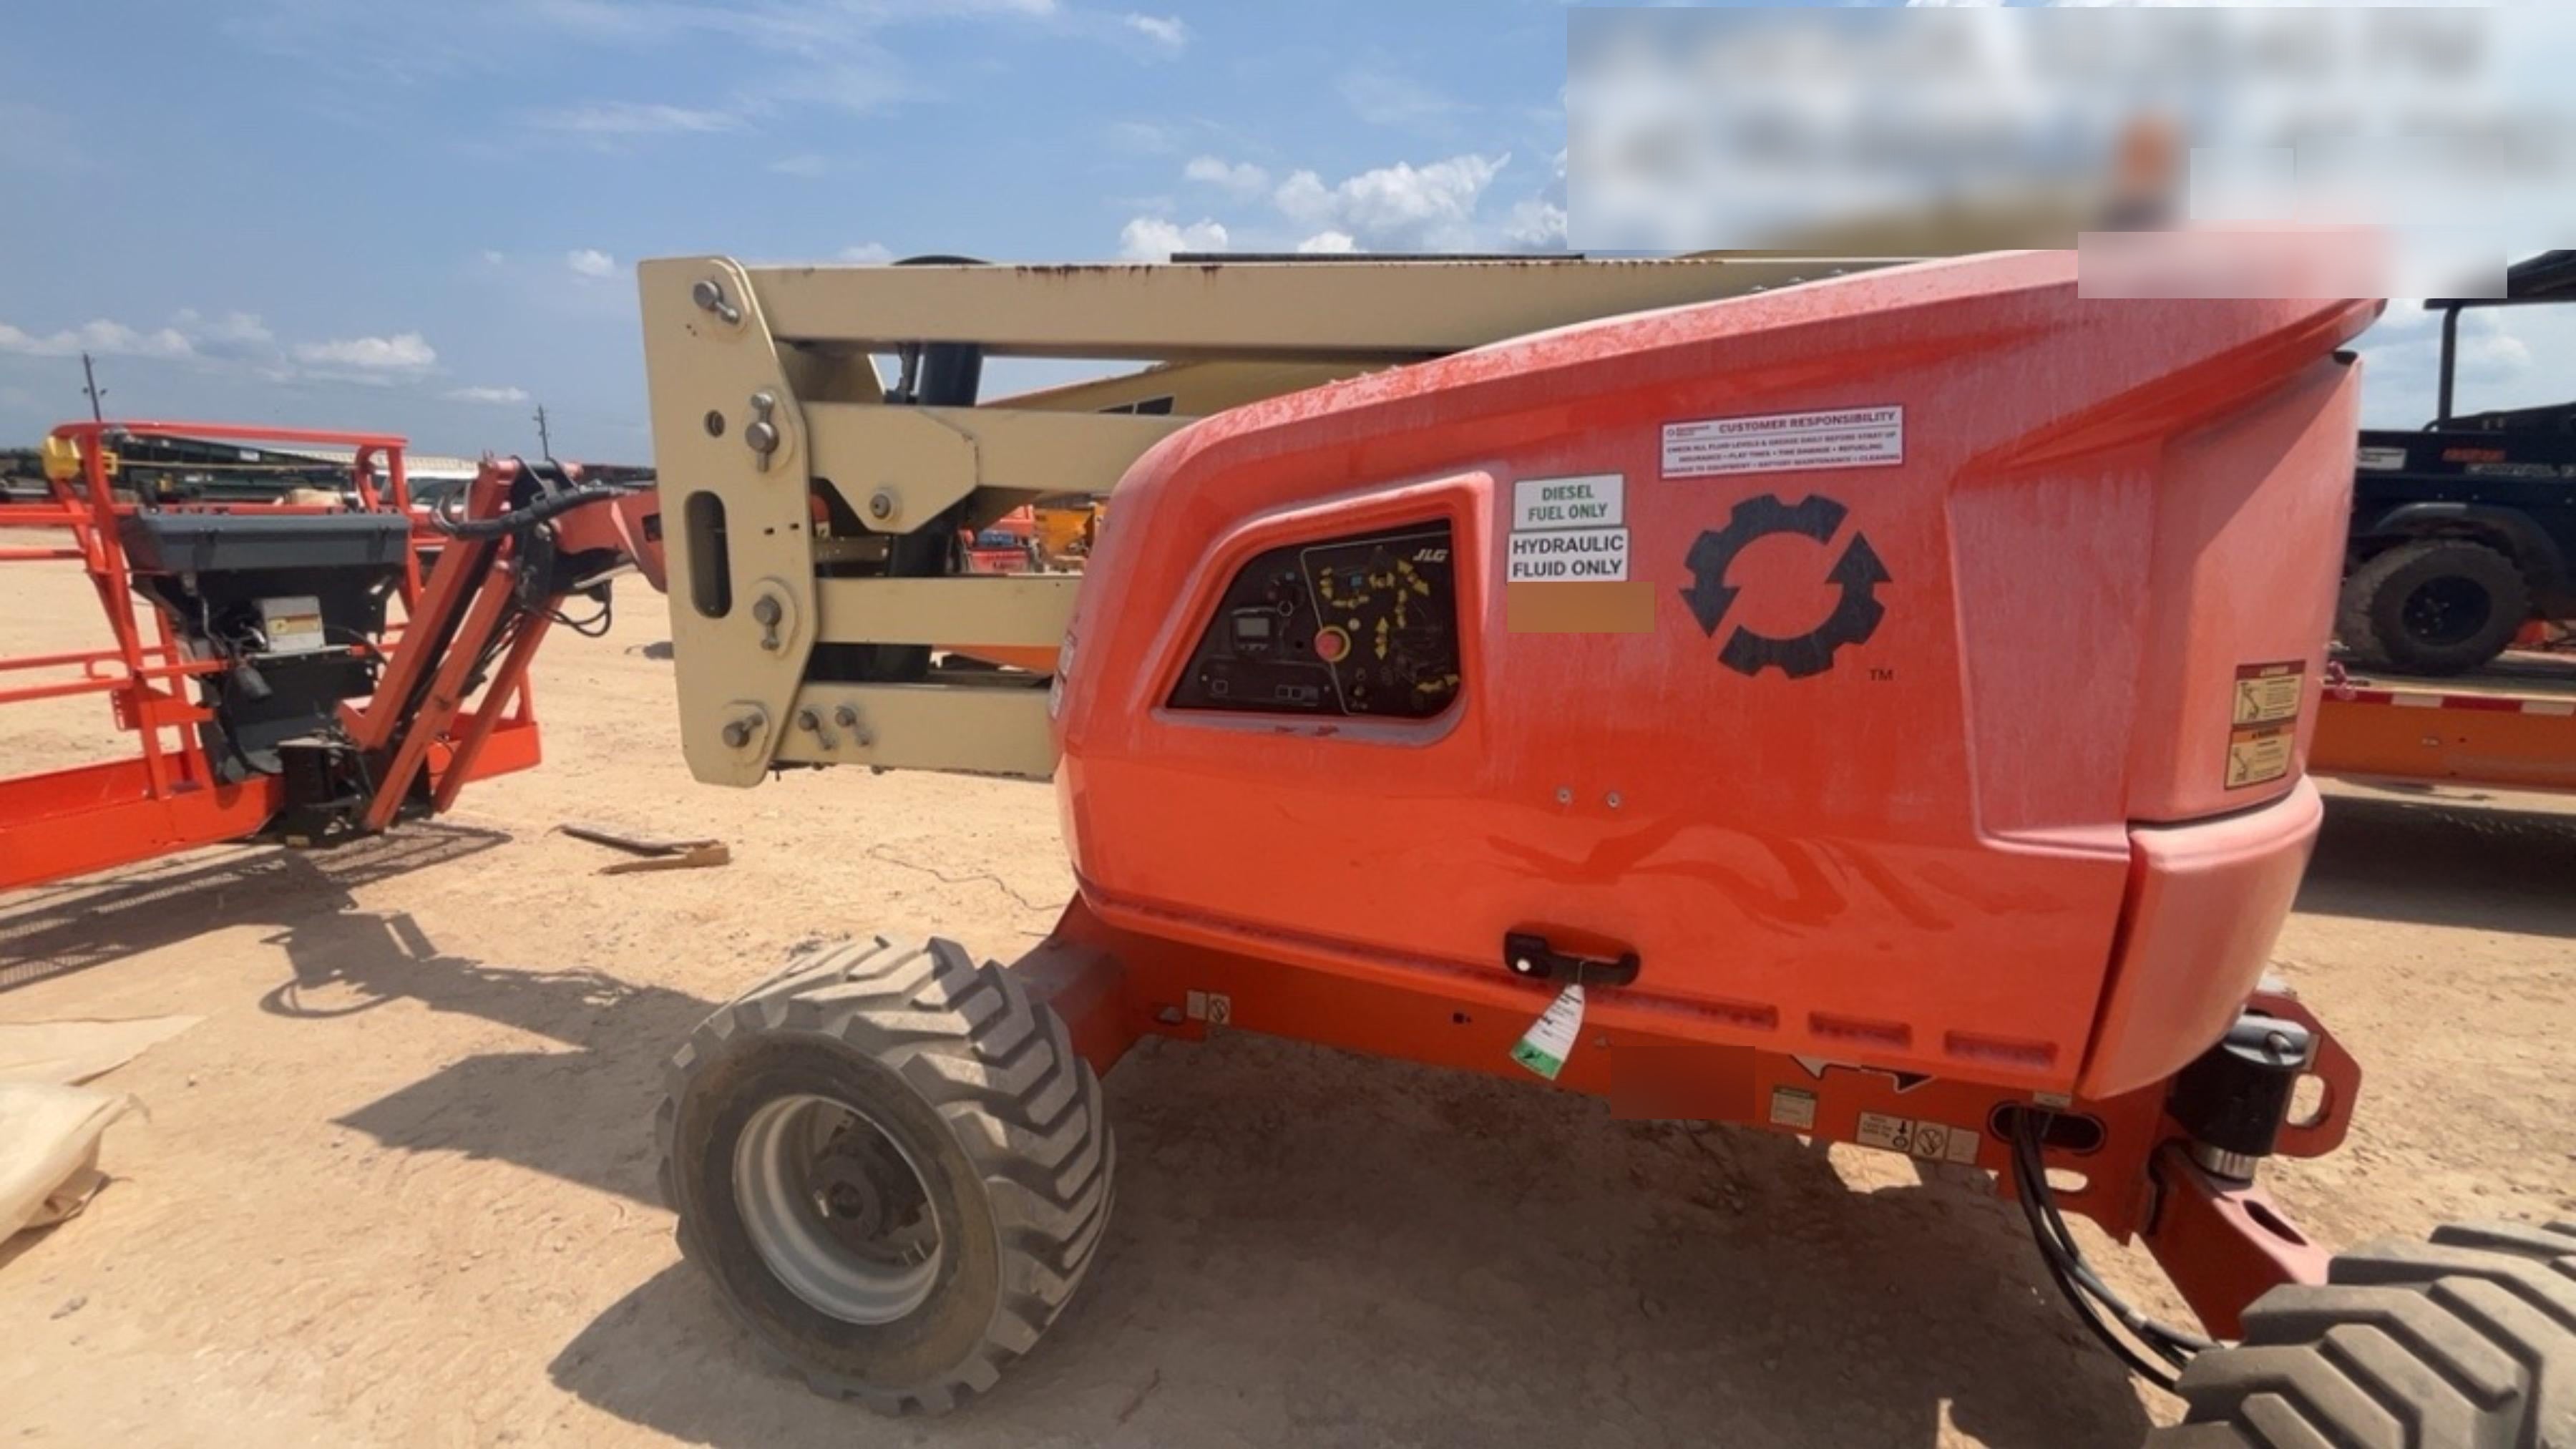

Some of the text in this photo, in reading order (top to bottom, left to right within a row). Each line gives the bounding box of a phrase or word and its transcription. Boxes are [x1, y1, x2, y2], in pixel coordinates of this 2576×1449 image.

[1719, 419, 1787, 434] CUSTOMER
[1790, 411, 1896, 427] RESPONSIBILITY
[1542, 484, 1594, 501] DIESEL
[1528, 502, 1608, 522] FUEL ONLY
[1513, 535, 1624, 555] HYDRAULIC
[1413, 548, 1448, 562] JLG
[1513, 559, 1622, 577] FLUID ONLY
[1870, 669, 1894, 681] TM
